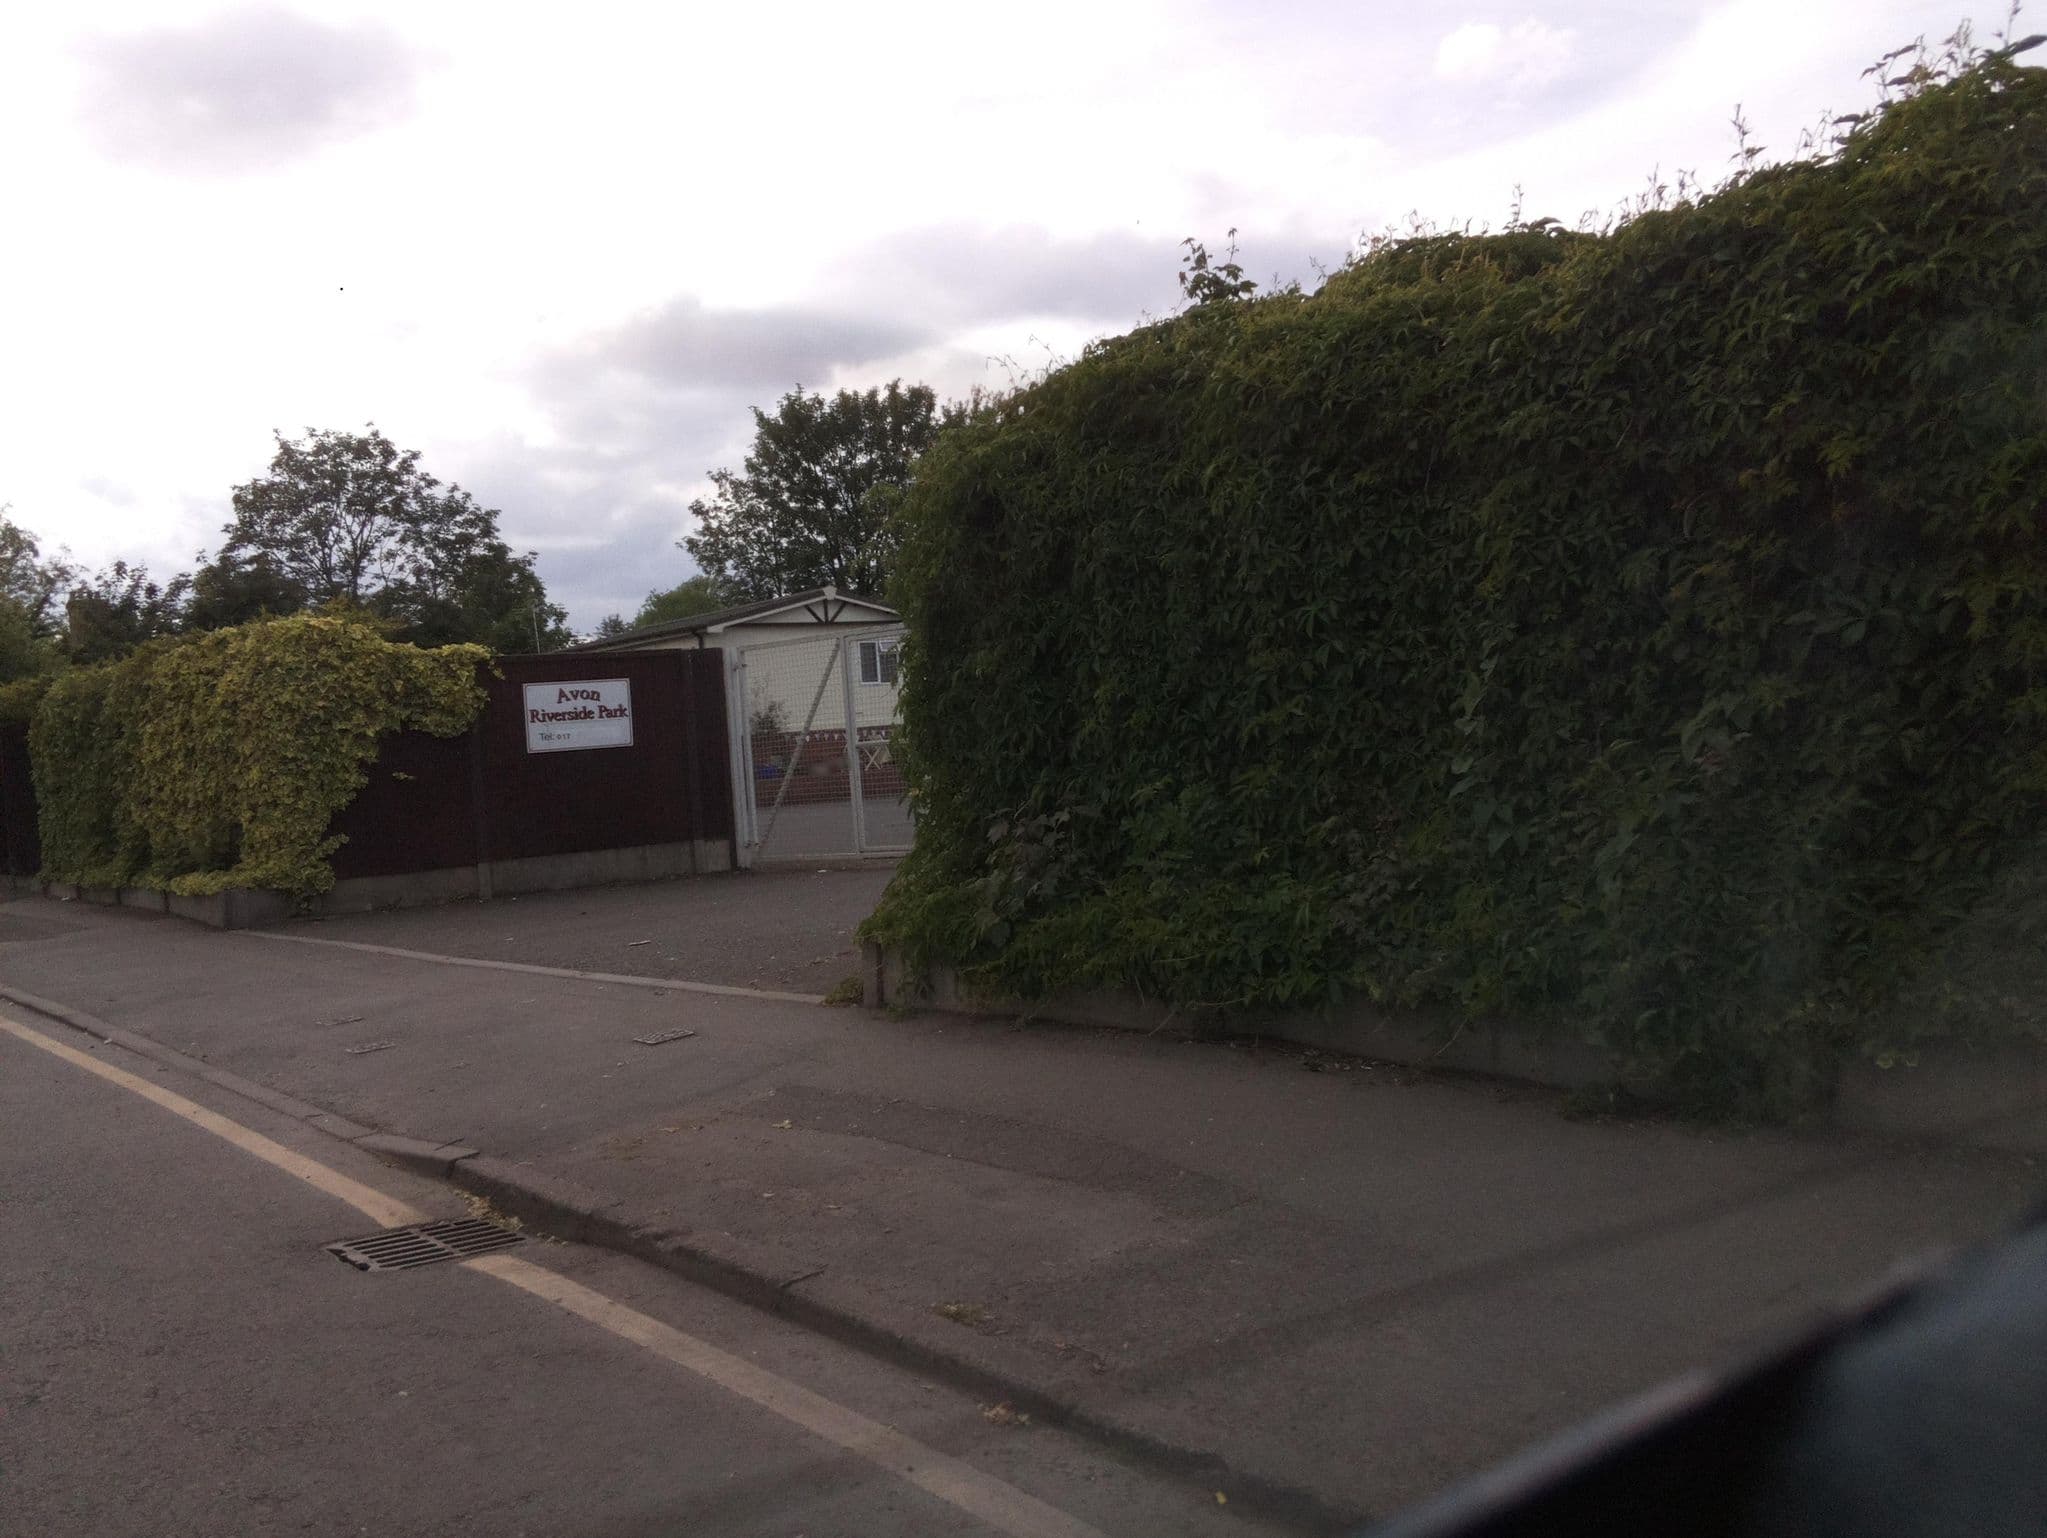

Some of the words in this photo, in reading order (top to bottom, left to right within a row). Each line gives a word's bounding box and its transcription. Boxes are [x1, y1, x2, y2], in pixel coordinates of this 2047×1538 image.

[557, 688, 601, 704] Avon
[529, 706, 595, 723] Riverside
[598, 704, 629, 719] Park
